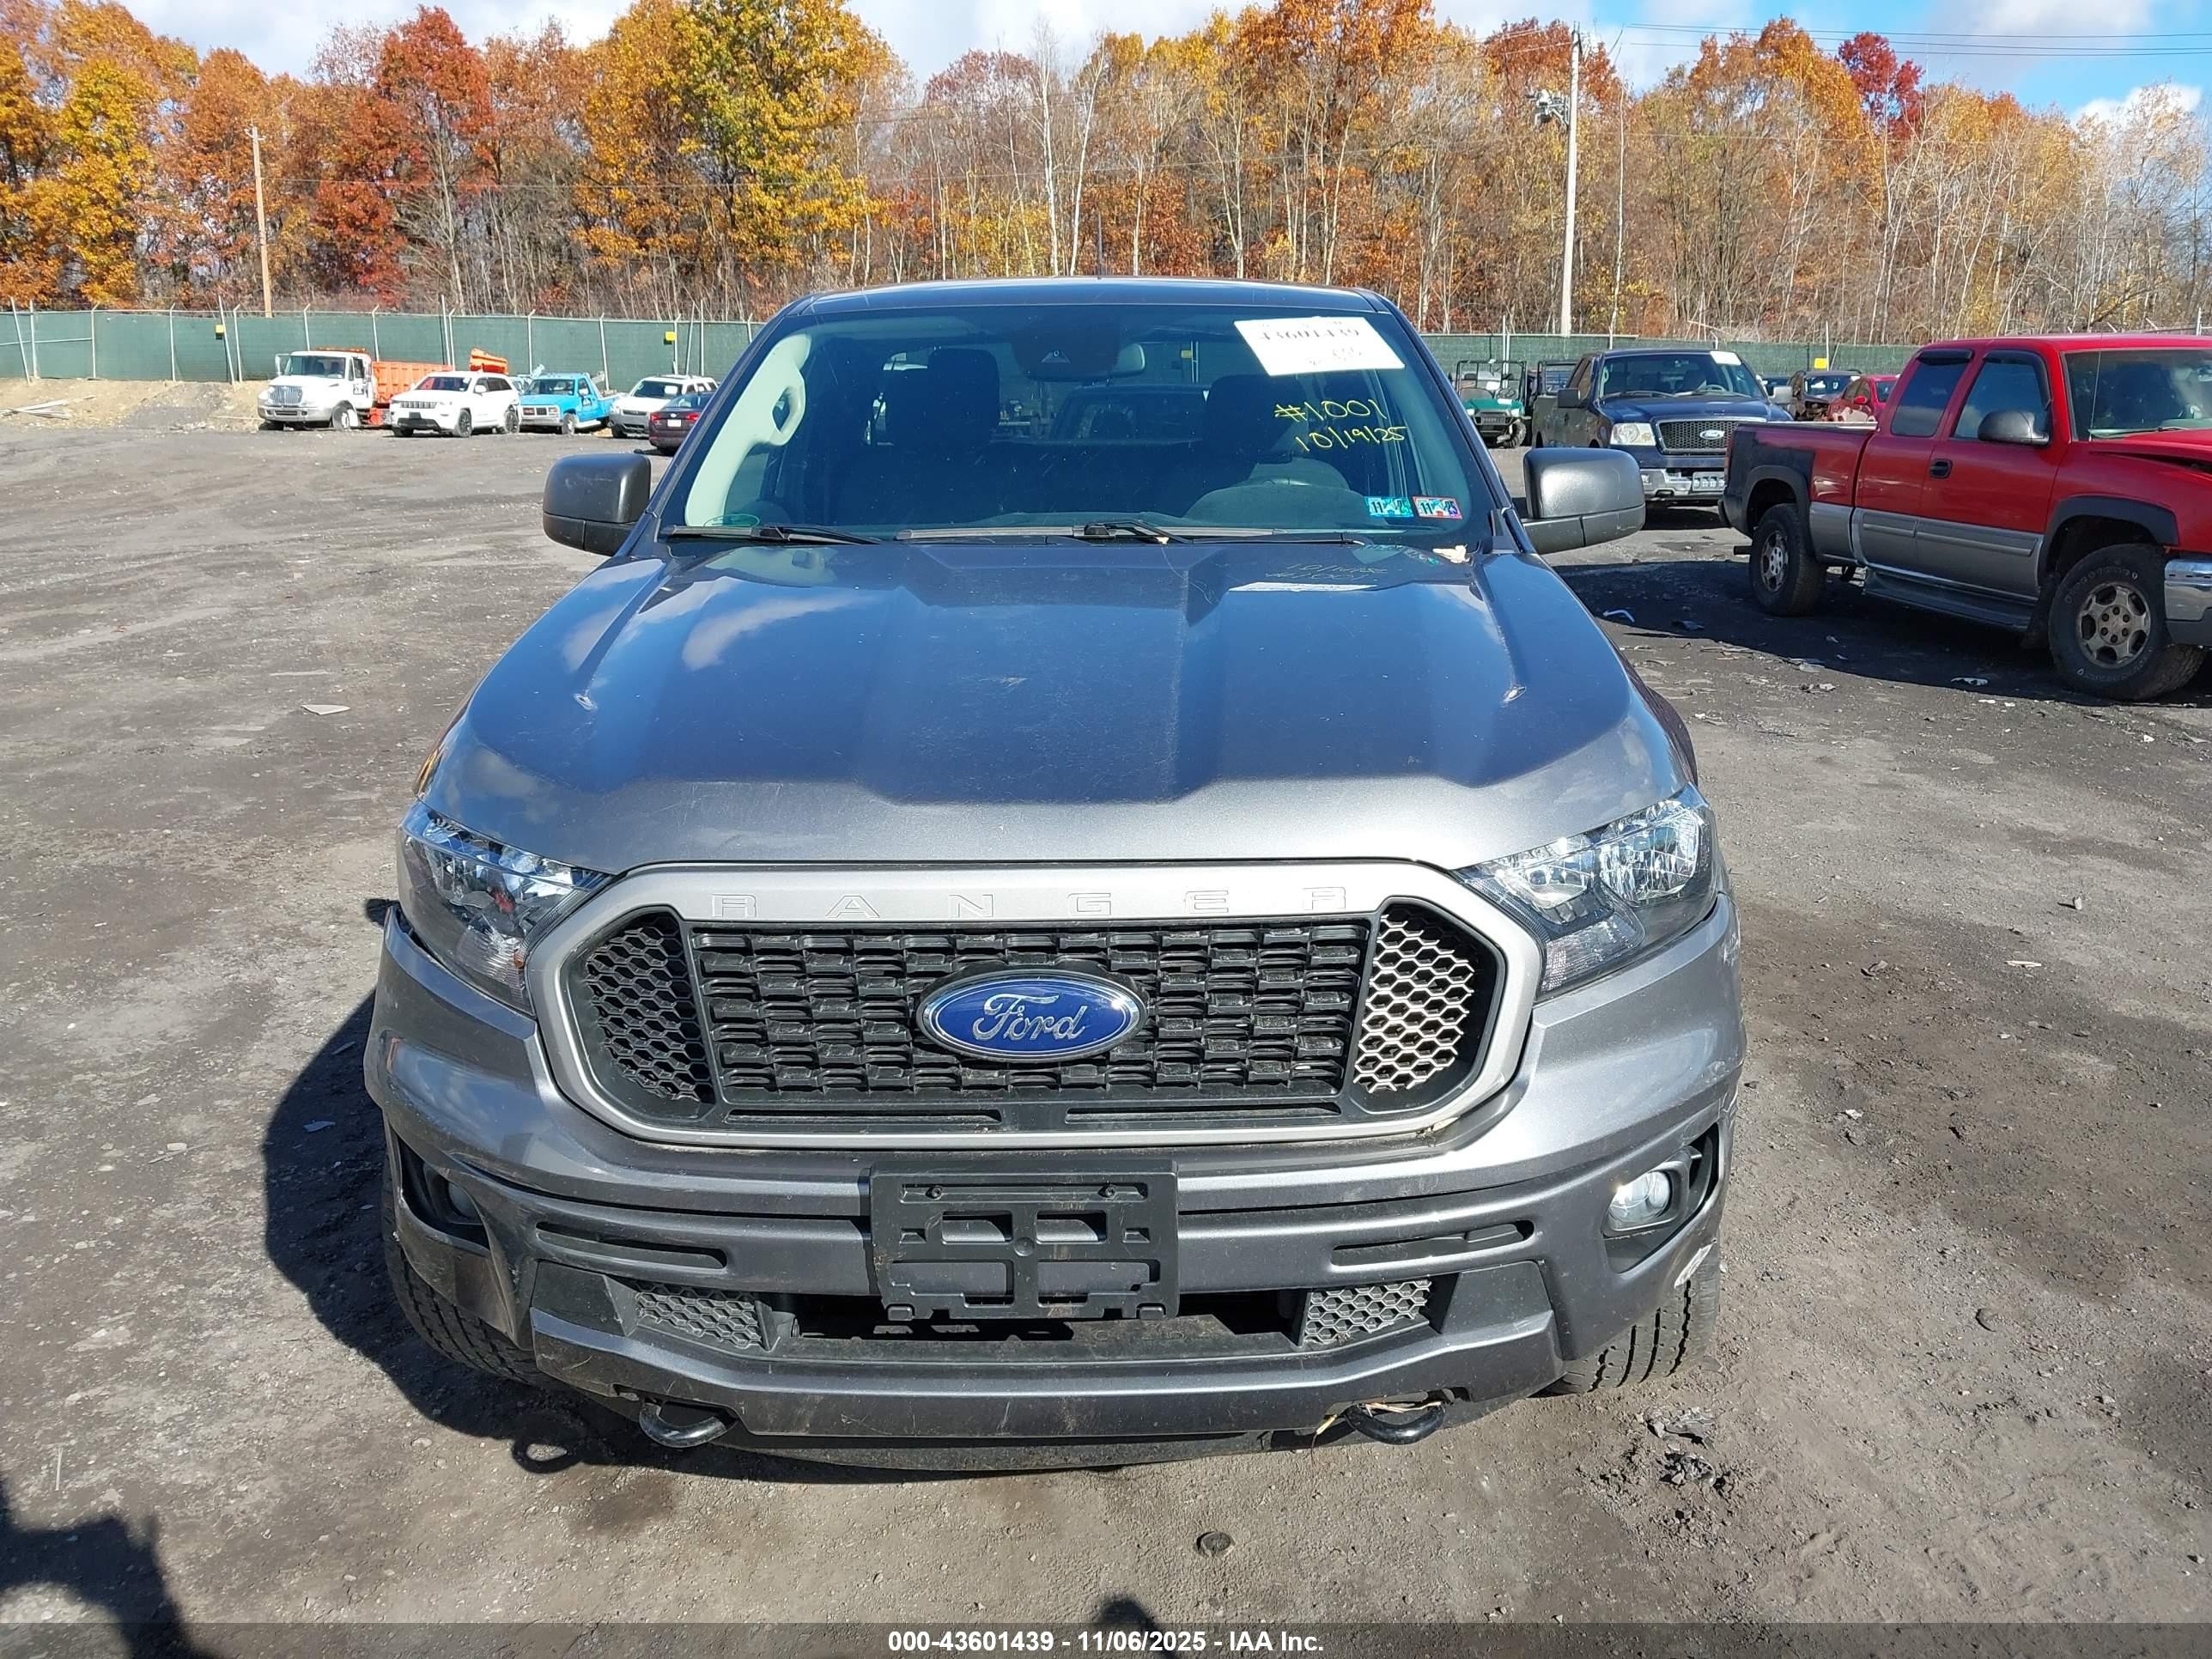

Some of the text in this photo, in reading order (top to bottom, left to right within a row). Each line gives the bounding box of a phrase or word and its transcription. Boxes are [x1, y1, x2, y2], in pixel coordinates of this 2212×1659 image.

[1274, 398, 1388, 422] #1001
[1295, 425, 1407, 452] 10/19/25
[1420, 501, 1433, 515] 11
[711, 886, 1346, 919] RANGER
[972, 993, 1088, 1041] Ford
